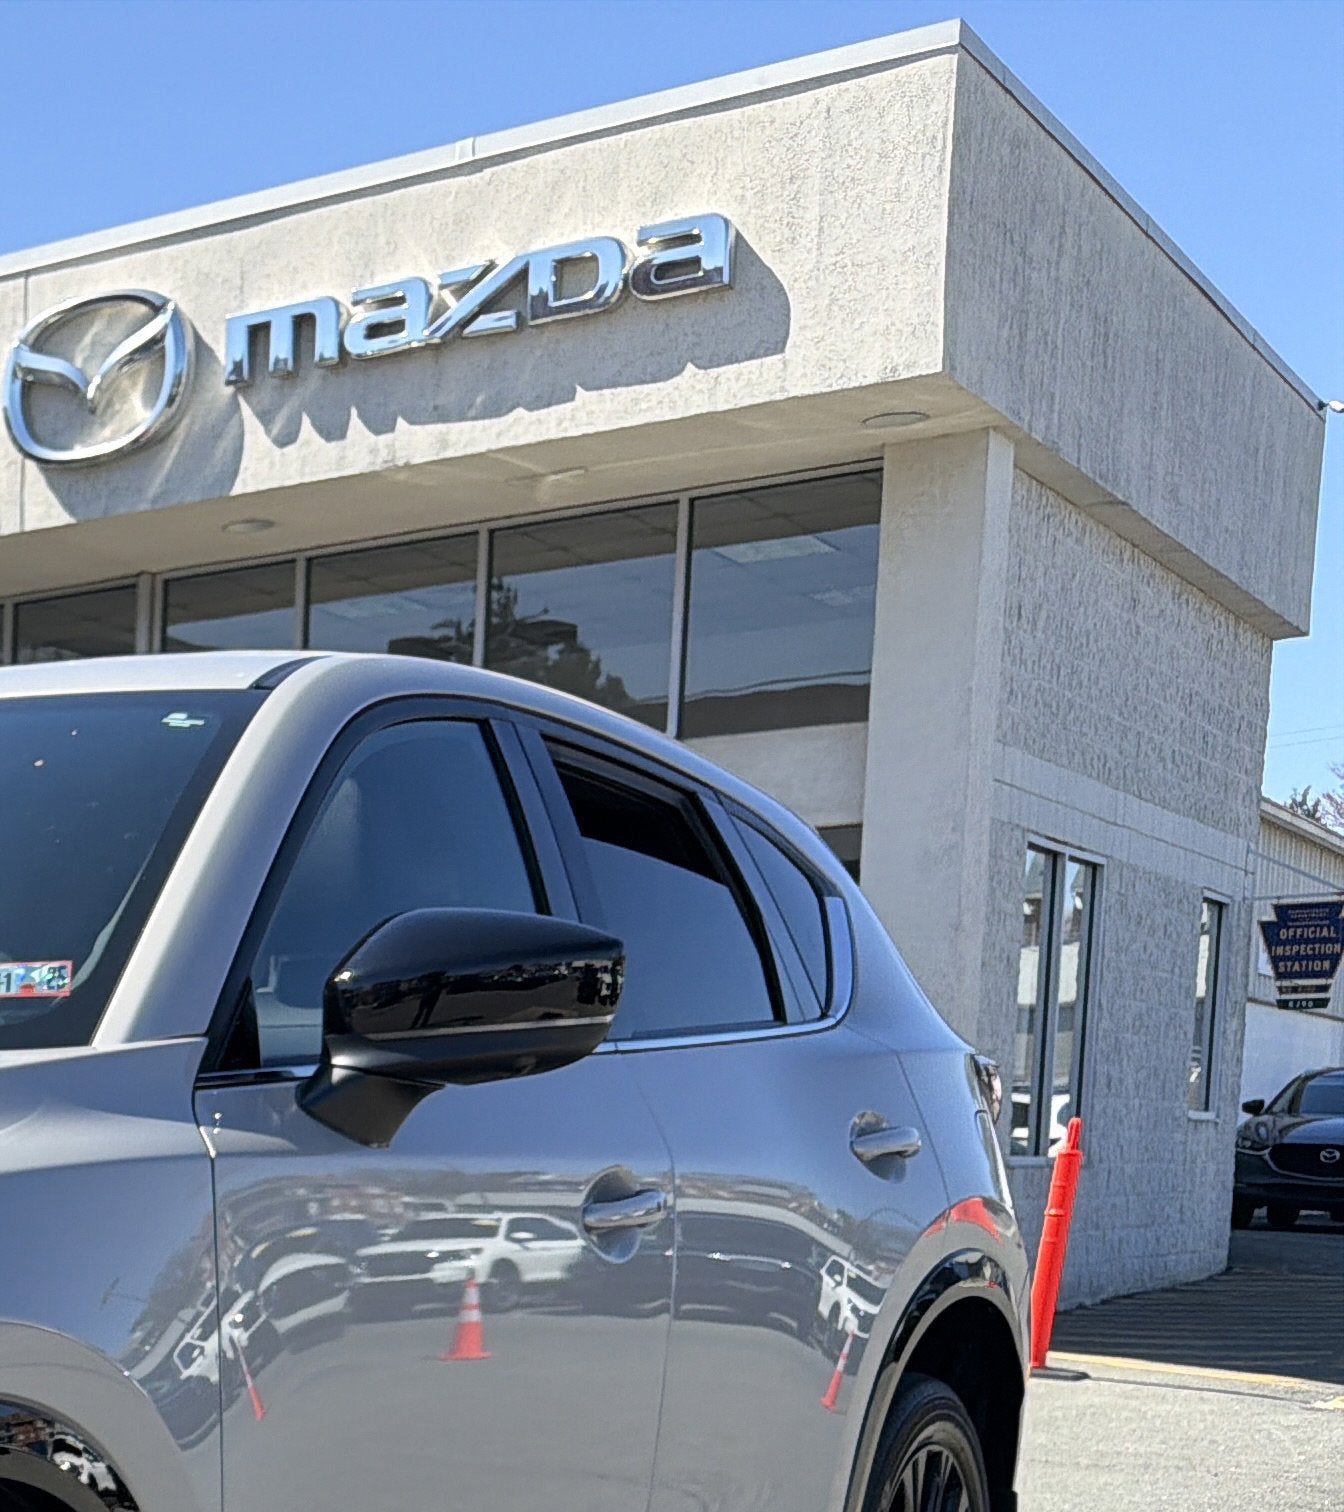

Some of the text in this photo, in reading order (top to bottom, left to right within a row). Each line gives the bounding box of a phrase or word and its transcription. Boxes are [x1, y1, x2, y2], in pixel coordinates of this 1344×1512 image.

[224, 211, 737, 387] mazda
[1279, 926, 1337, 940] OFFICIAL
[1271, 943, 1342, 957] INSPECTION
[1277, 960, 1331, 973] STATION
